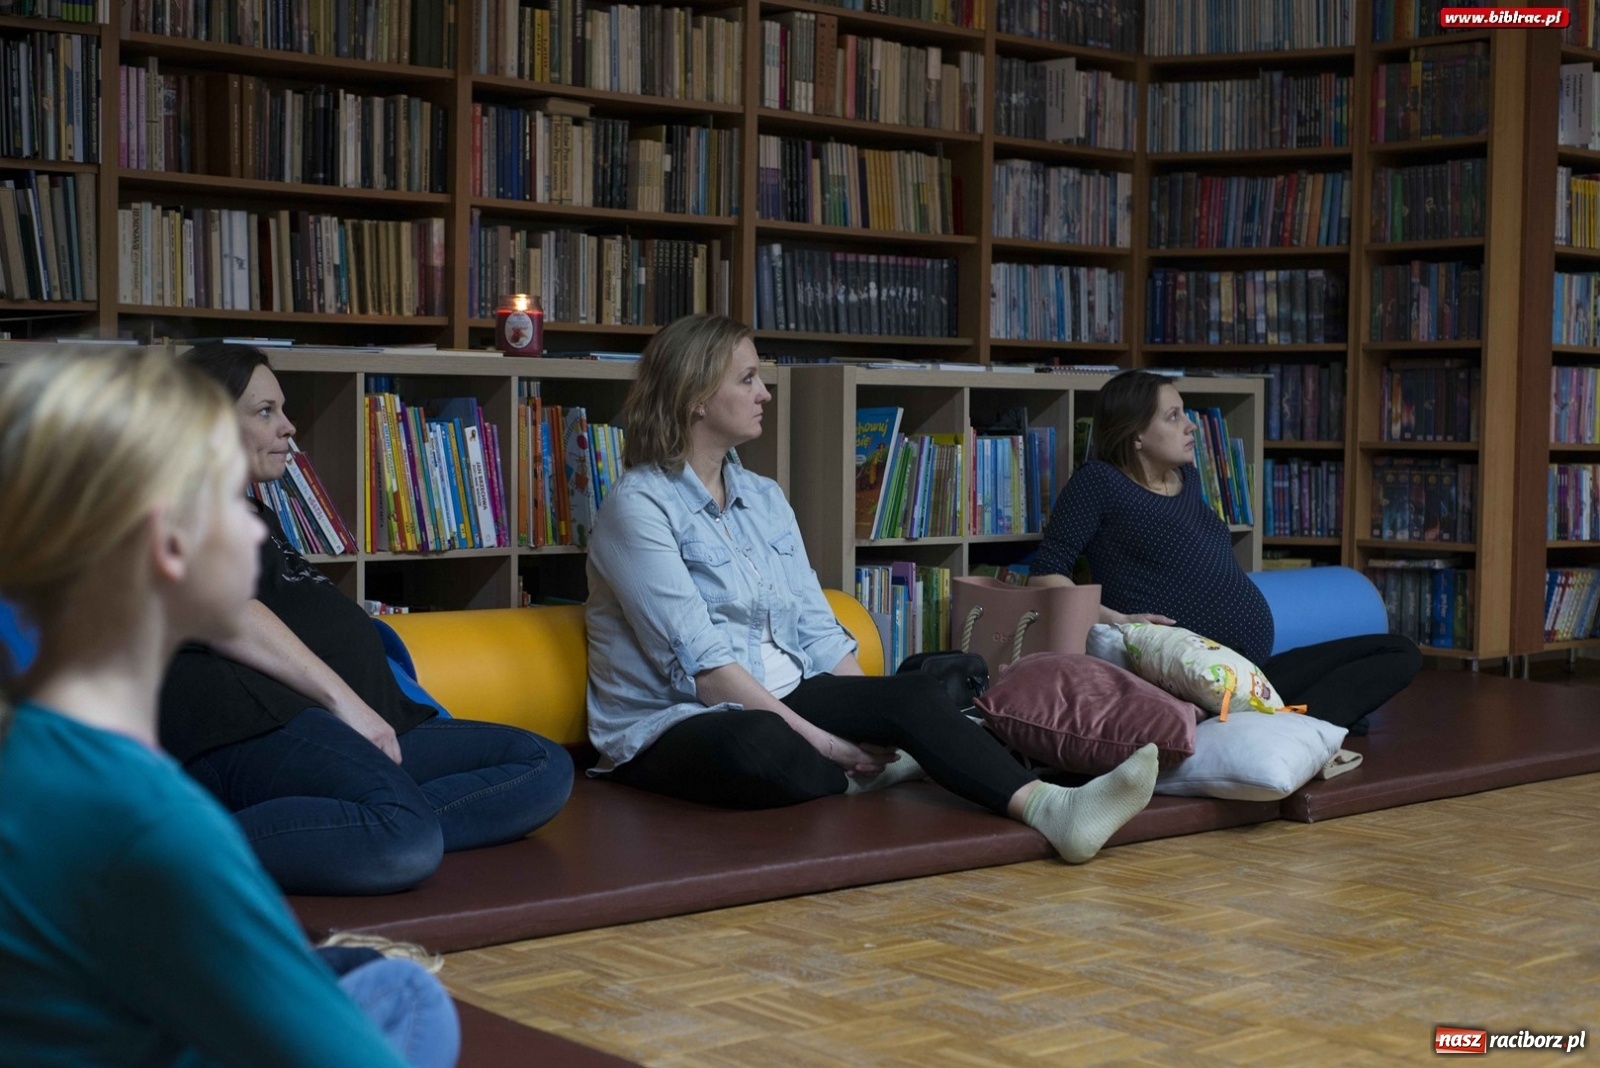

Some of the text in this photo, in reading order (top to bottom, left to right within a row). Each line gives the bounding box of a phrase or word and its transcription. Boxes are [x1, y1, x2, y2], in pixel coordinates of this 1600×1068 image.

[132, 208, 140, 251] HEMINGWAY
[475, 462, 488, 511] JAN BRZECHWA
